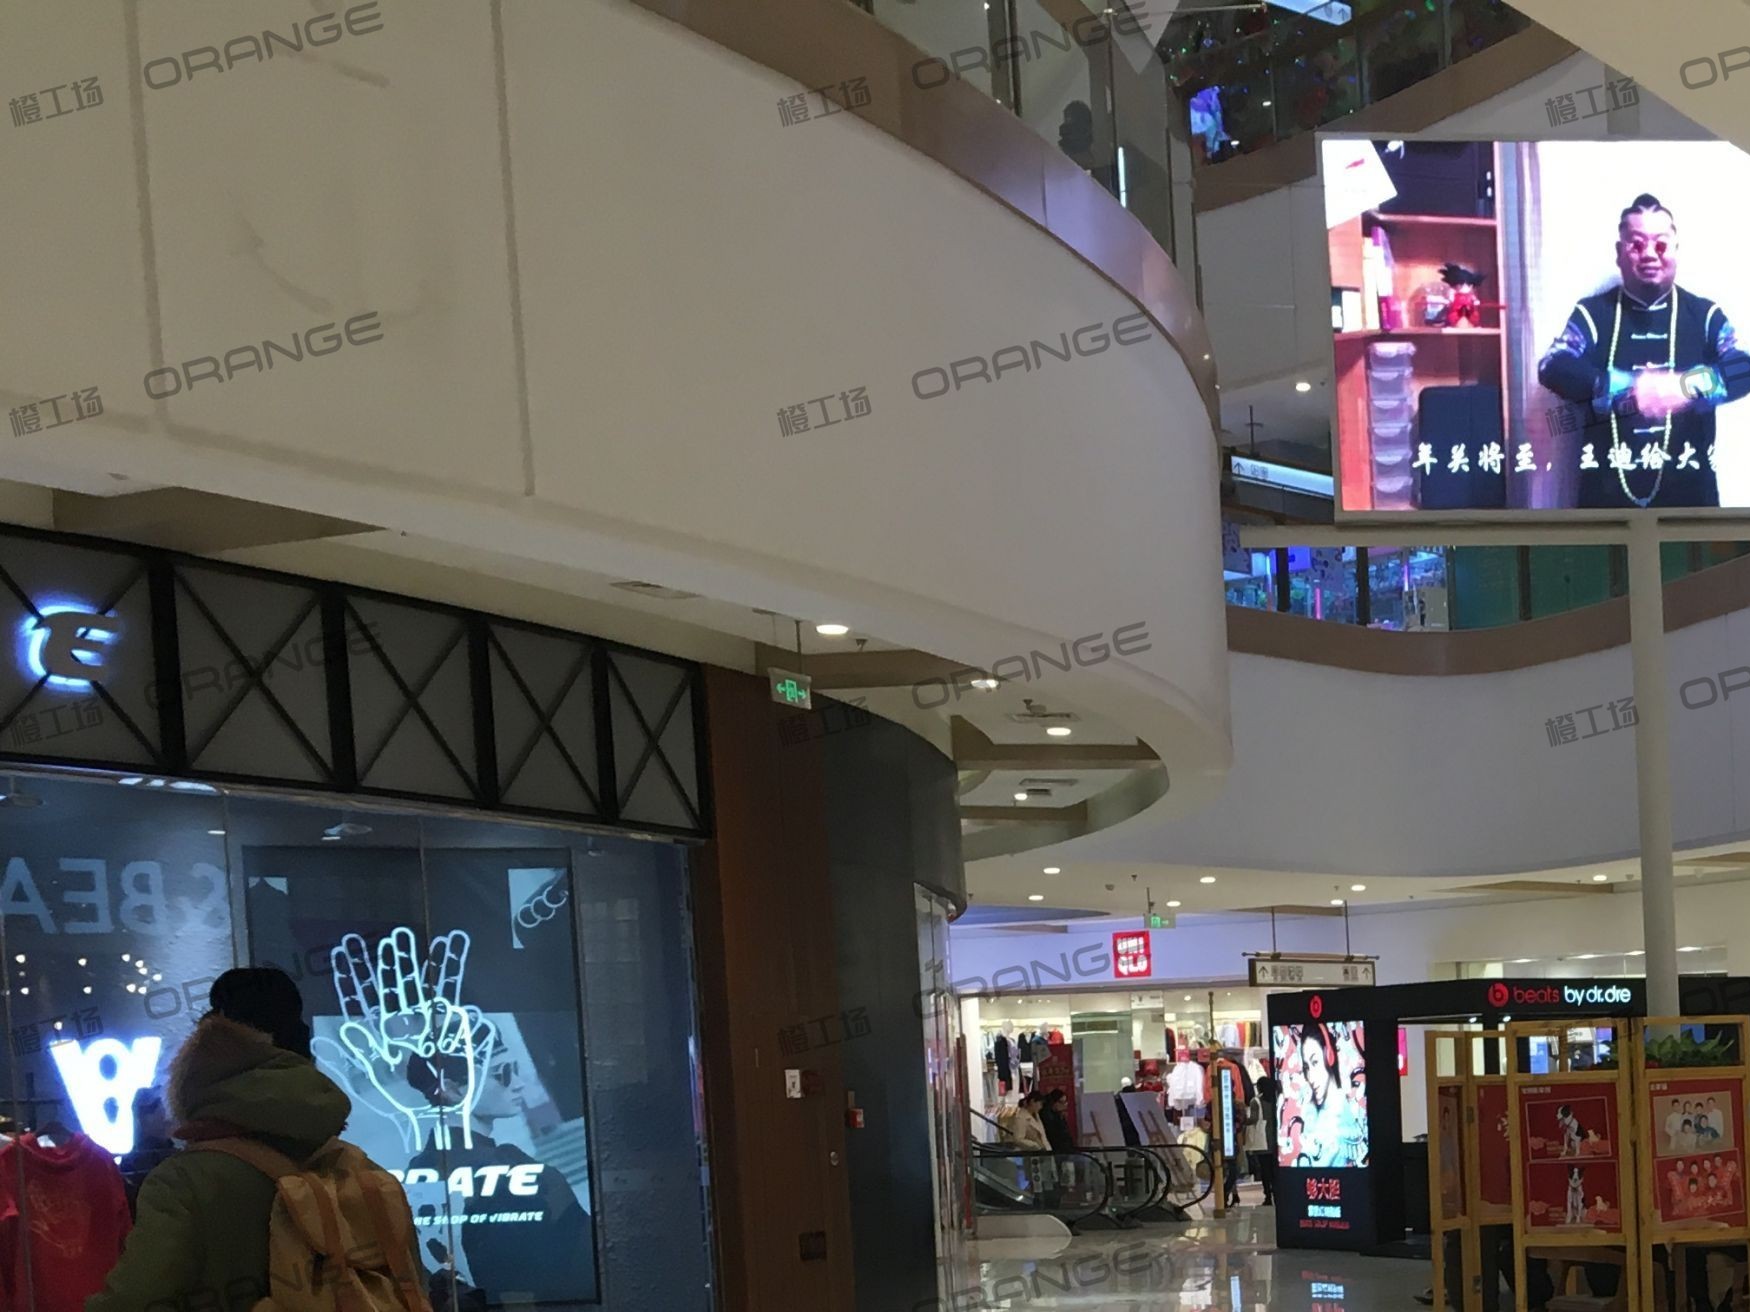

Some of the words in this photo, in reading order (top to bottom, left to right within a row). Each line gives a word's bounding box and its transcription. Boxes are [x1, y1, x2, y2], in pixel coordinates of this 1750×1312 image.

[1117, 937, 1144, 954] UNI
[1118, 955, 1147, 976] QLO
[1513, 986, 1560, 1004] beats
[1564, 985, 1583, 1006] by
[1586, 985, 1631, 1003] dr.dre
[470, 1213, 487, 1224] OF
[489, 1211, 544, 1223] VIBRATE
